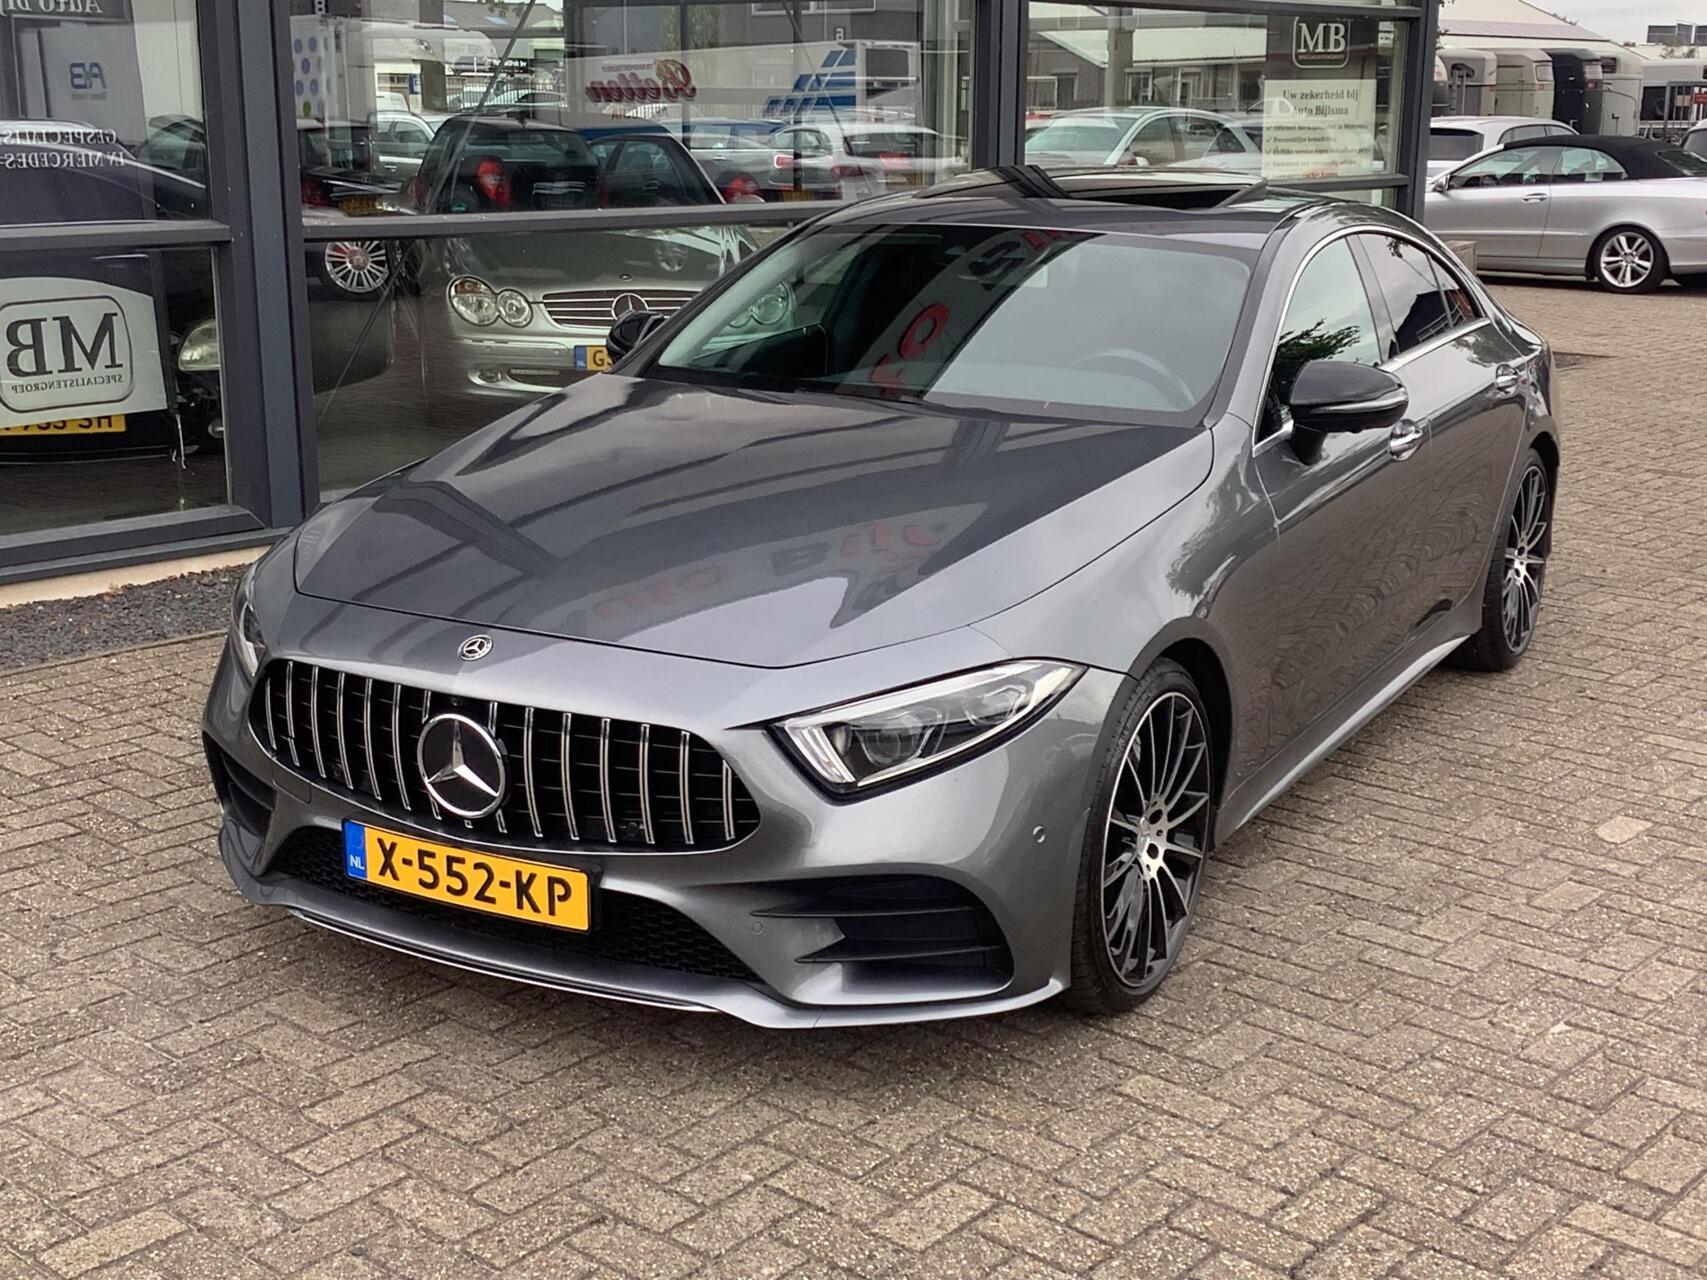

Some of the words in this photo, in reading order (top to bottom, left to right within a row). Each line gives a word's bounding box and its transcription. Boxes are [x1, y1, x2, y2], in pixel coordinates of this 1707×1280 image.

[1297, 22, 1346, 53] MB
[1283, 90, 1297, 99] Uw
[1300, 89, 1344, 100] zekerheid
[1346, 89, 1359, 102] bij
[1315, 105, 1349, 117] Bijlsma
[350, 855, 365, 870] NL
[377, 837, 572, 917] X-552-KP
